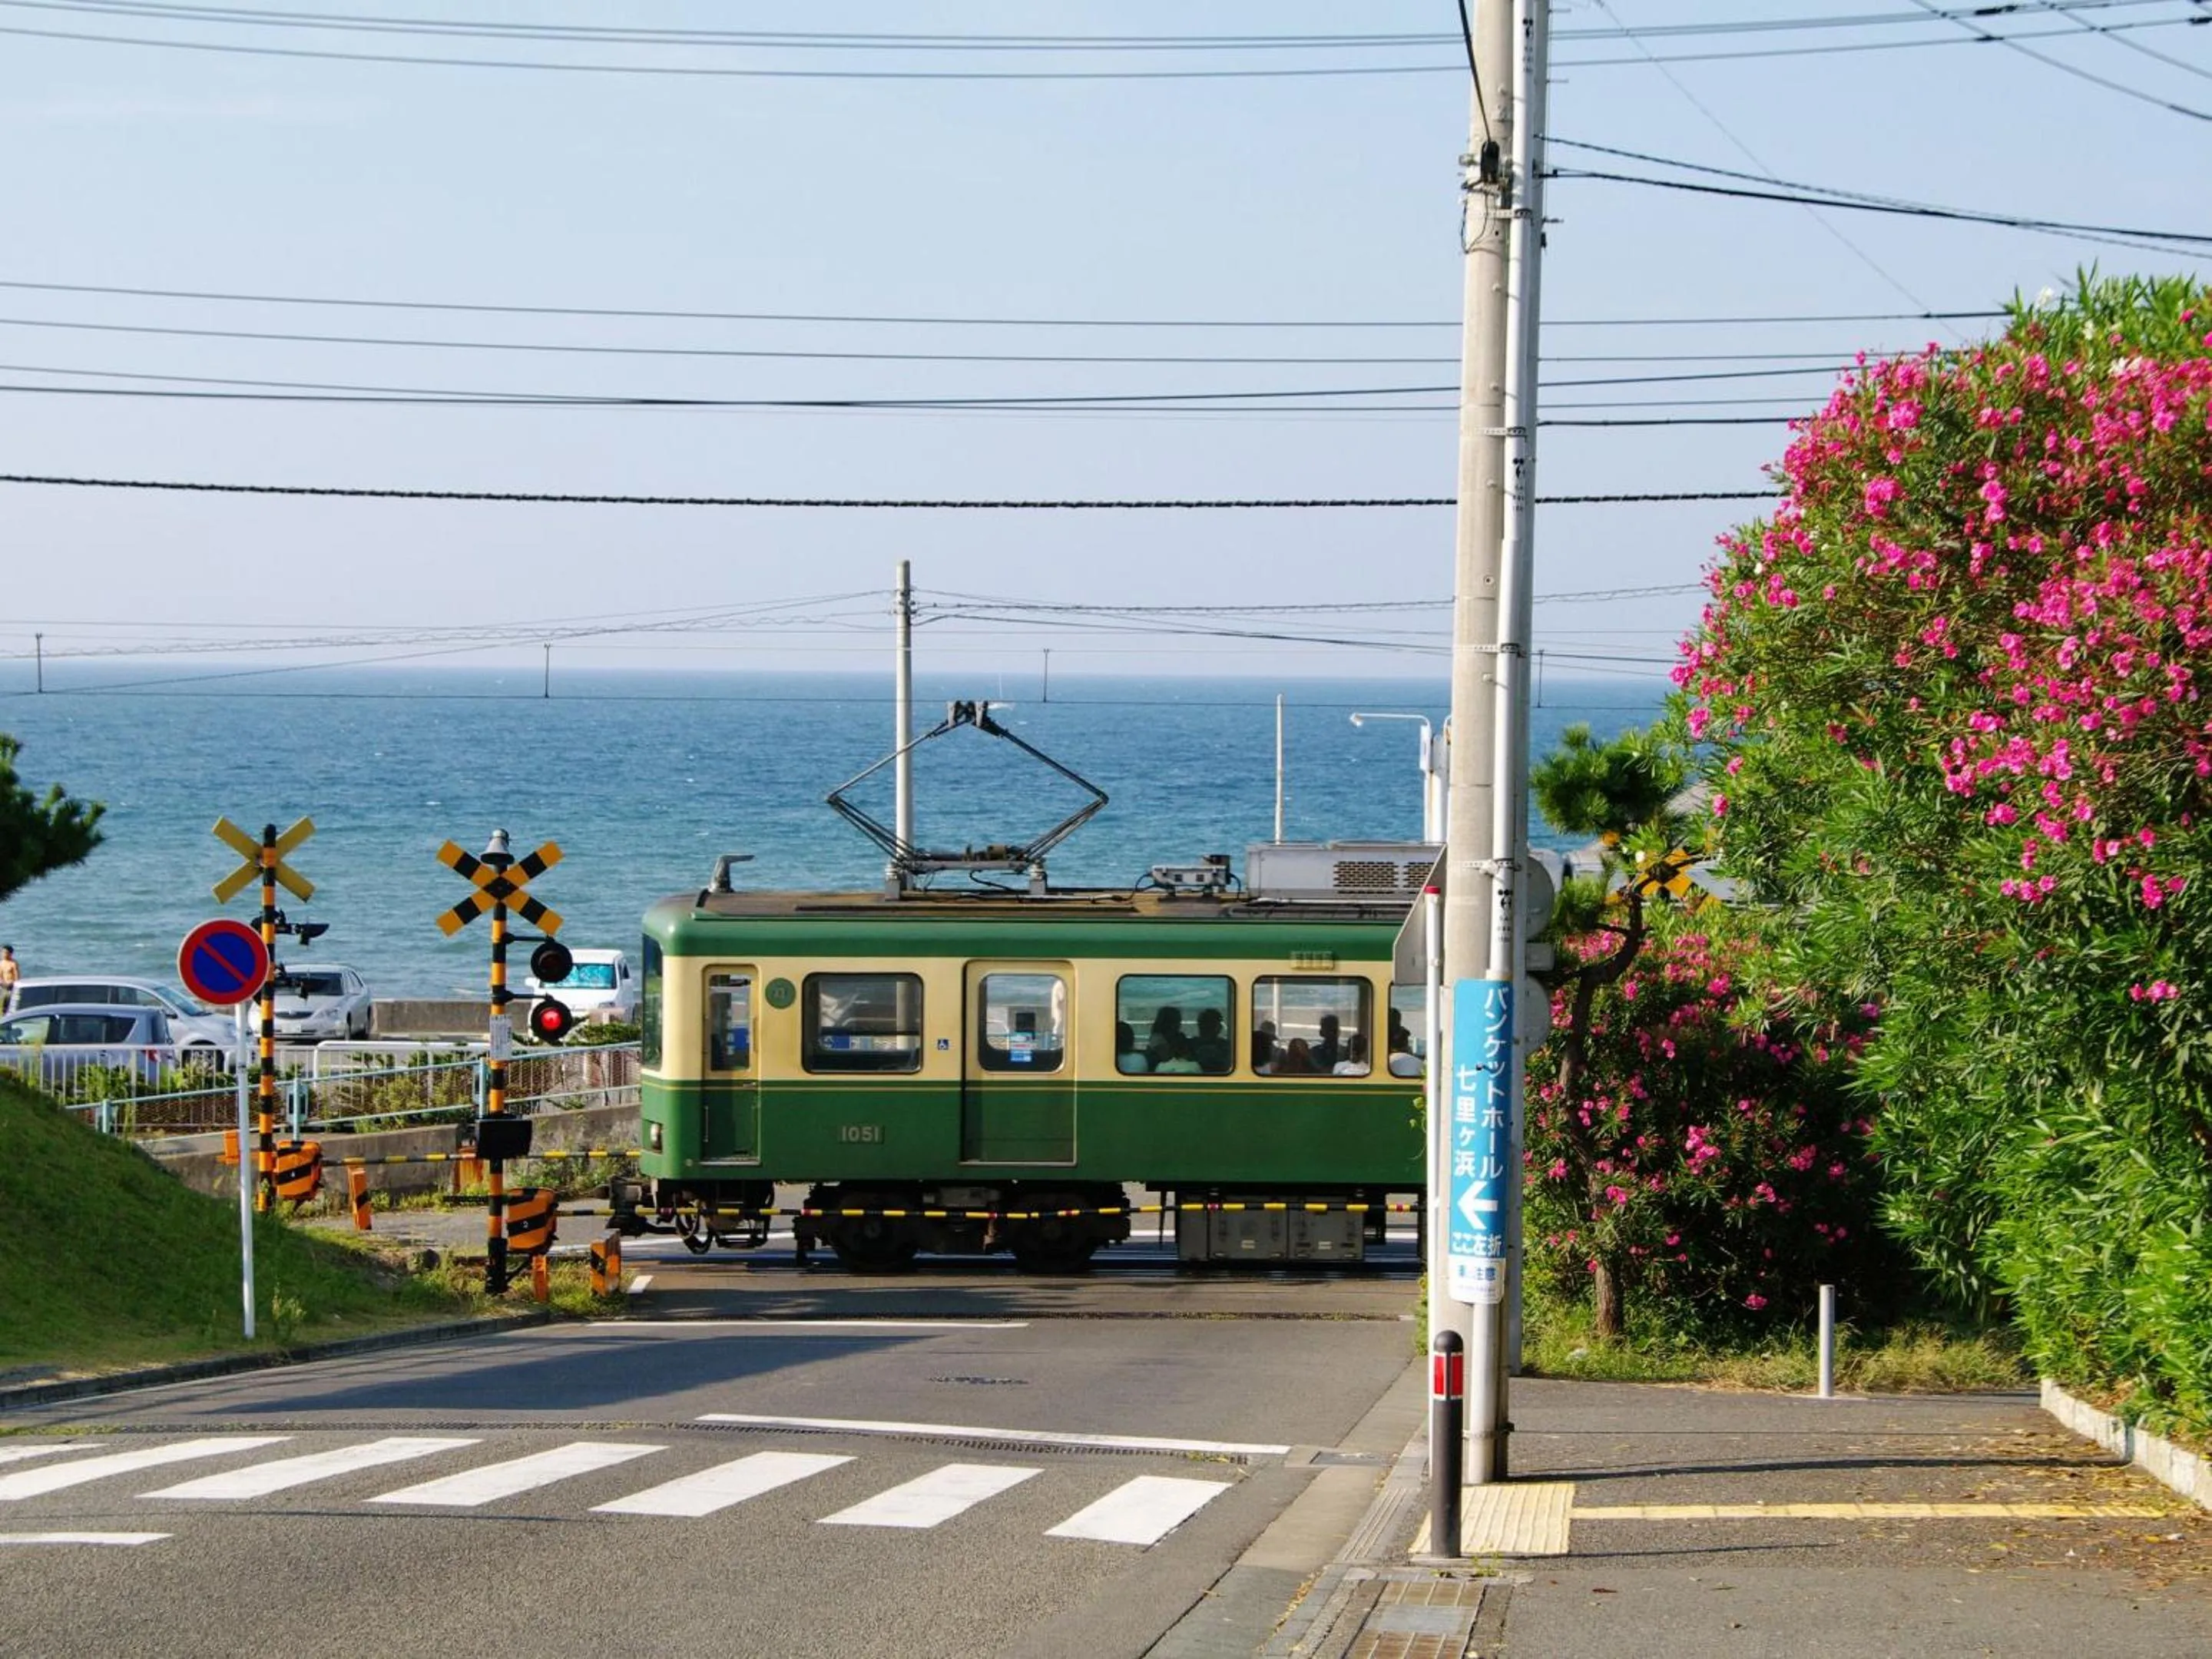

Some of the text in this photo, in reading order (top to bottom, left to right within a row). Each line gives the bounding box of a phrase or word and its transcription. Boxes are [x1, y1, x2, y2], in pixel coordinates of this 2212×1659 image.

[1480, 986, 1508, 1179] バンケットホール
[842, 1126, 879, 1143] 1051
[1452, 1232, 1502, 1257] ここ左折
